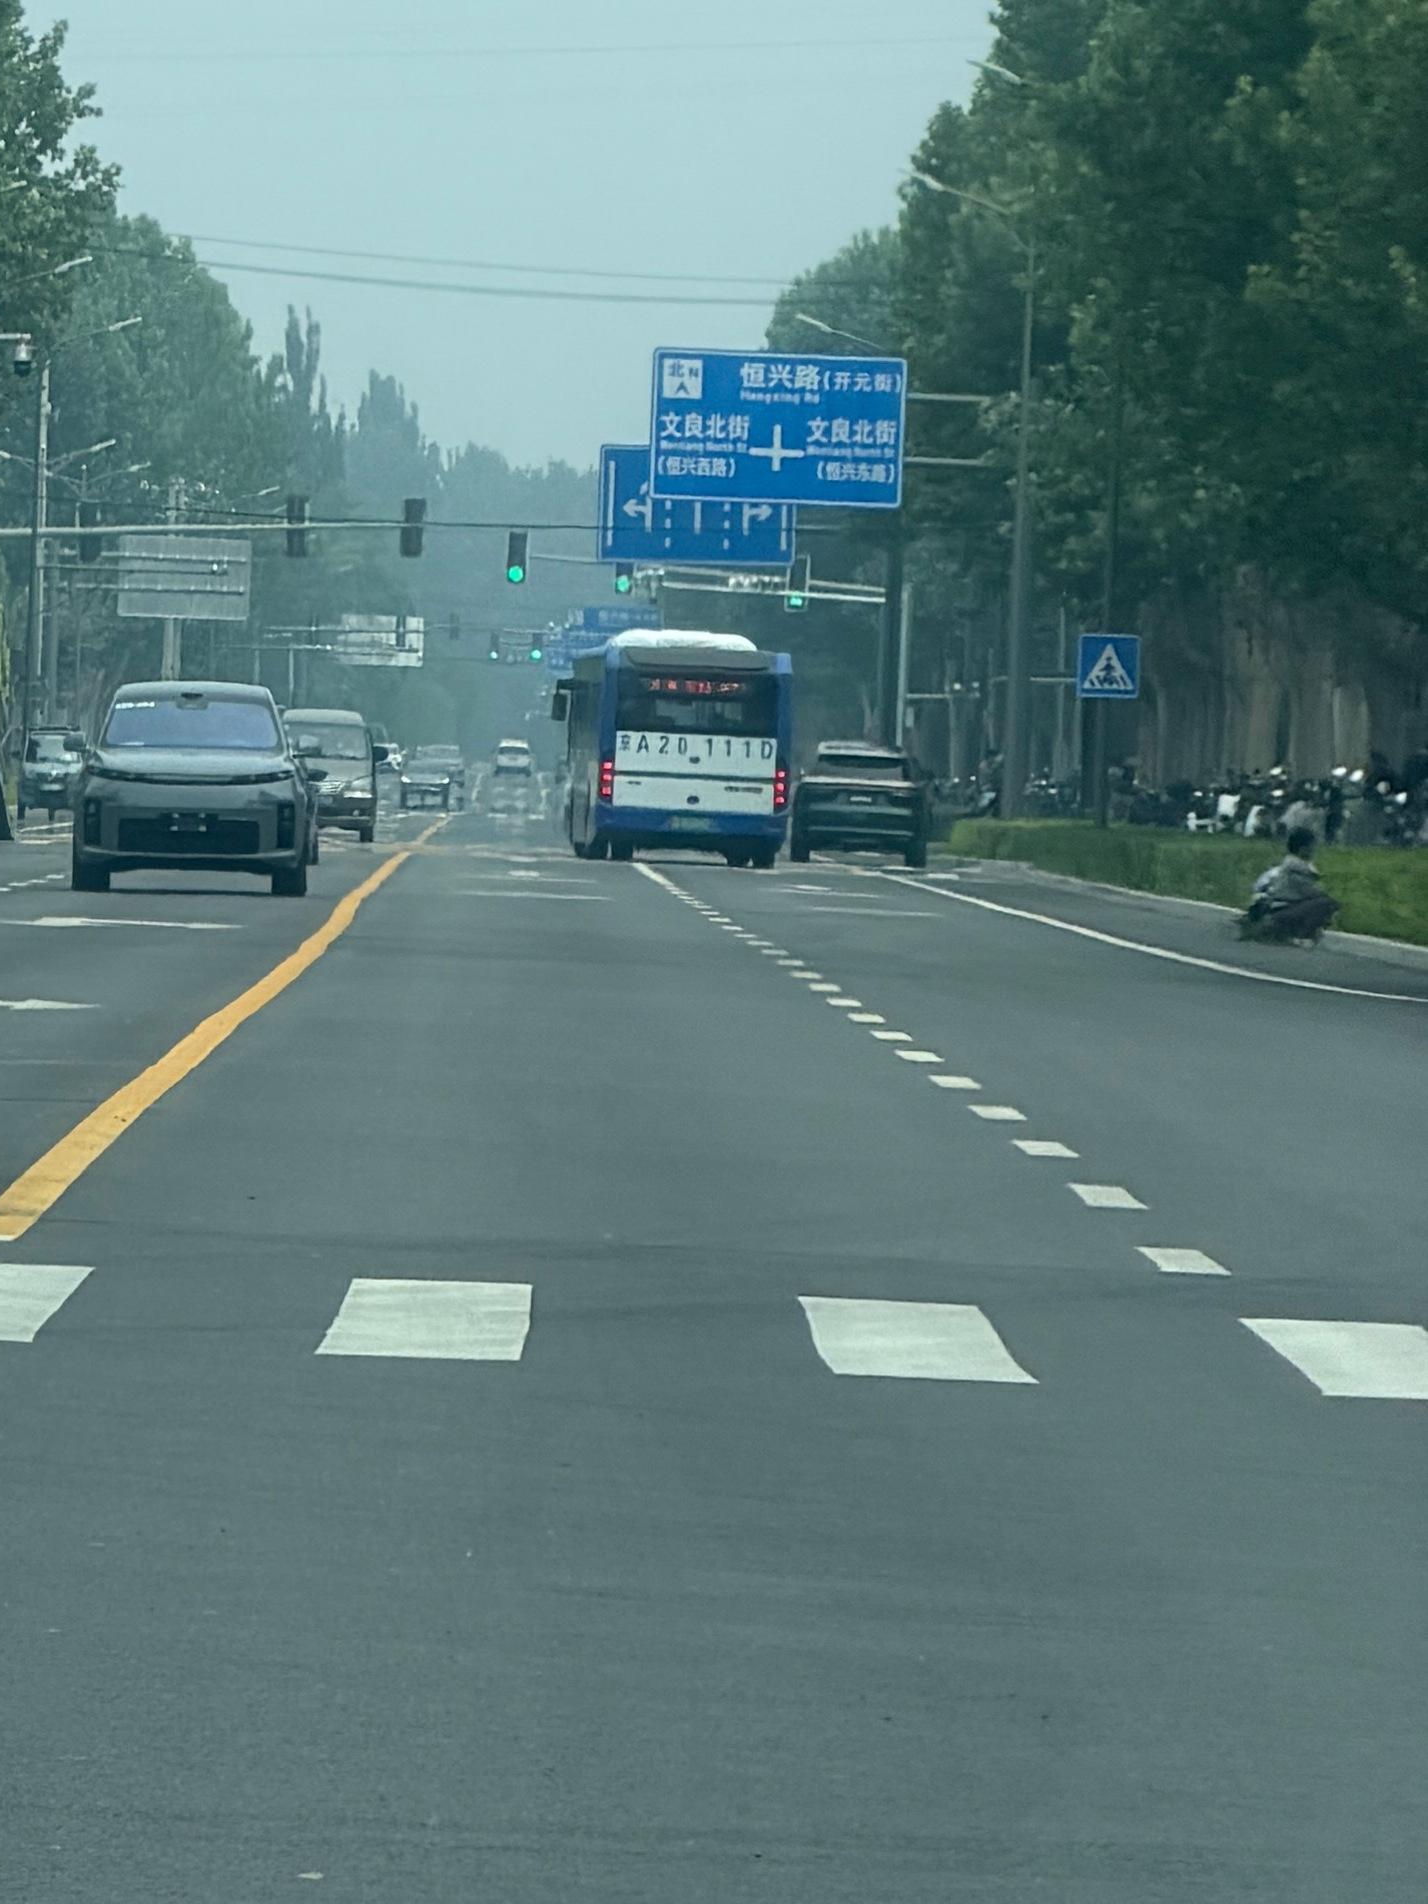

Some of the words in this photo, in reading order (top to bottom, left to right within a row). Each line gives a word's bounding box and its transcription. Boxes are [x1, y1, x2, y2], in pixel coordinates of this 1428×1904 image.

[668, 360, 685, 377] 北
[659, 411, 750, 441] 文良北街
[806, 416, 898, 445] 文良北街
